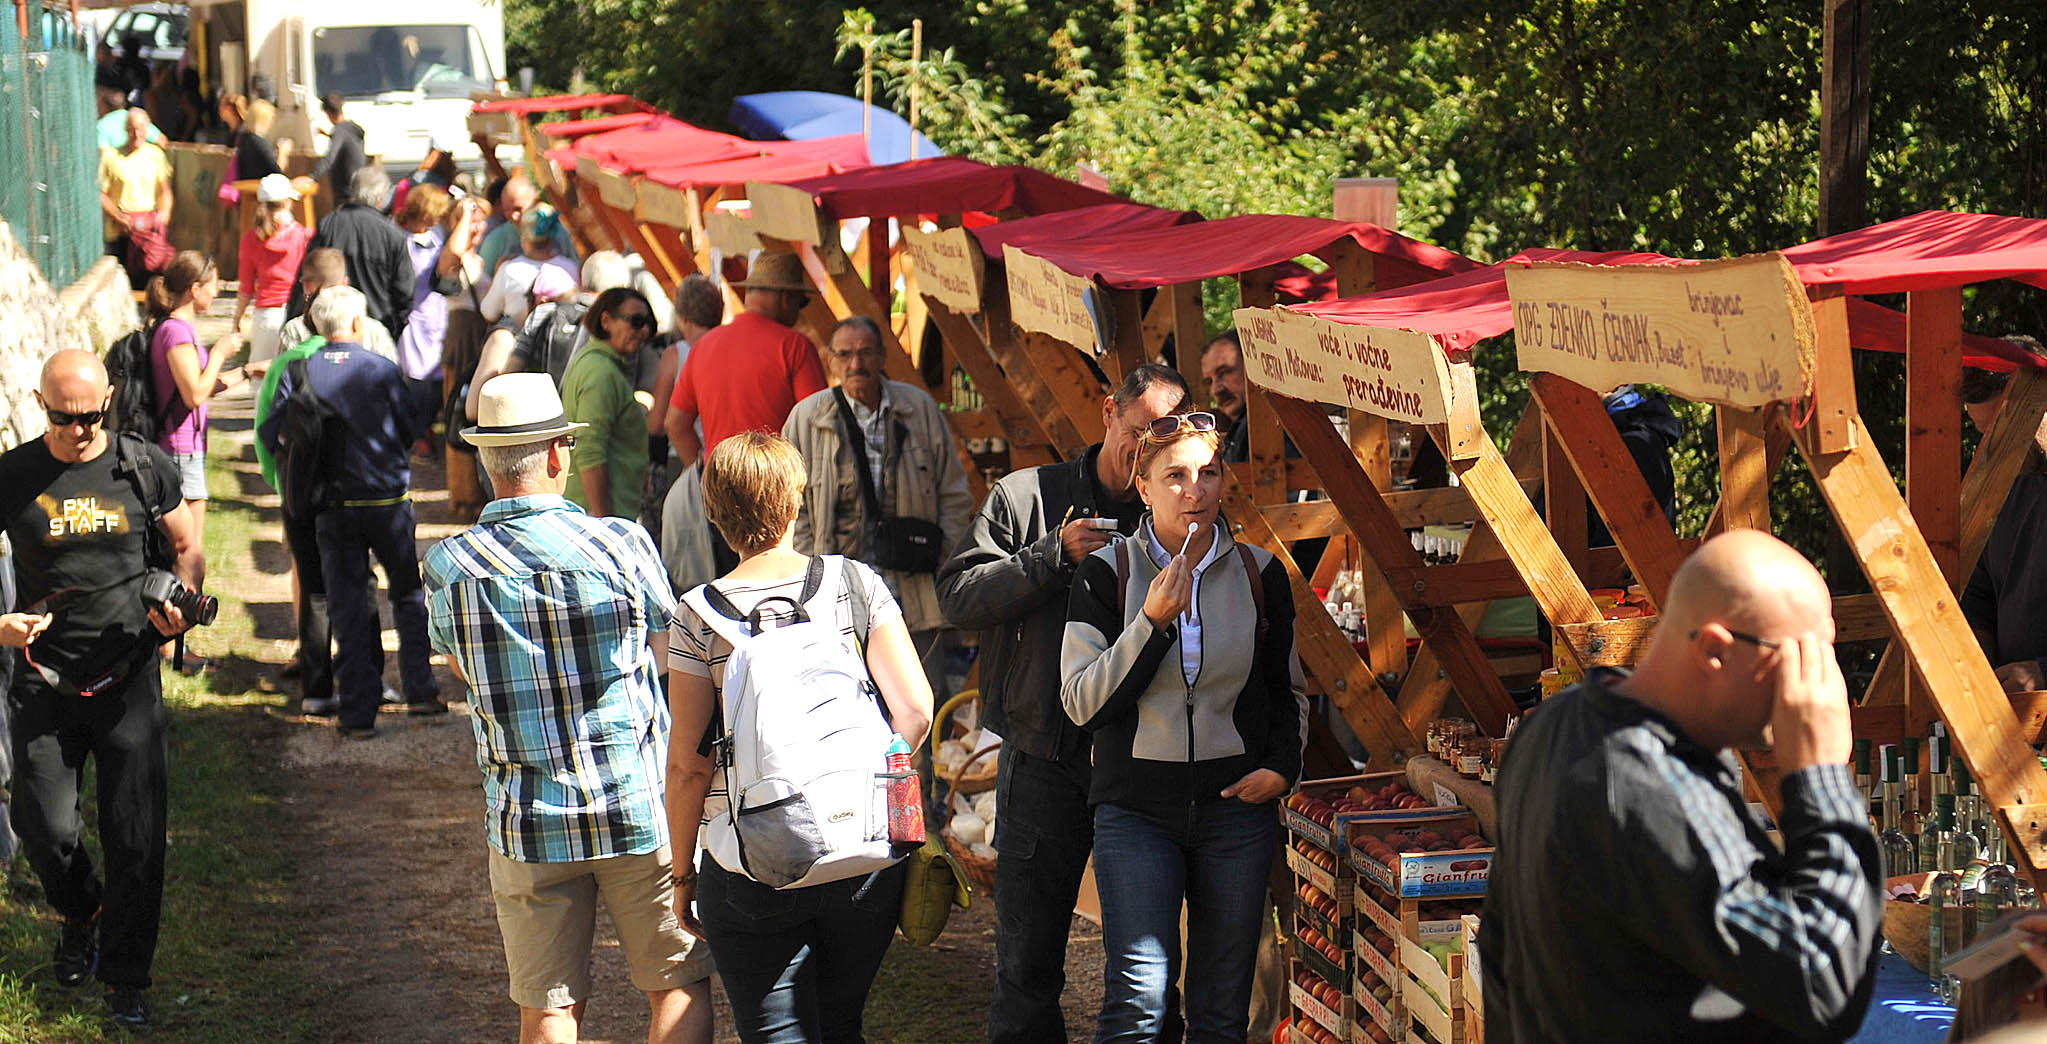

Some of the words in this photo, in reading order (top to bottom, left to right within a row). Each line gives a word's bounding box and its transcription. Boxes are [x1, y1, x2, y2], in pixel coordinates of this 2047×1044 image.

[1317, 324, 1342, 357] voće
[1343, 332, 1353, 361] i
[1353, 334, 1392, 372] voćne
[1517, 301, 1543, 347] OPG
[1546, 302, 1598, 361] ZDENKO
[1342, 373, 1424, 418] prerađevine
[49, 513, 120, 536] STAFF
[63, 497, 105, 521] PXL
